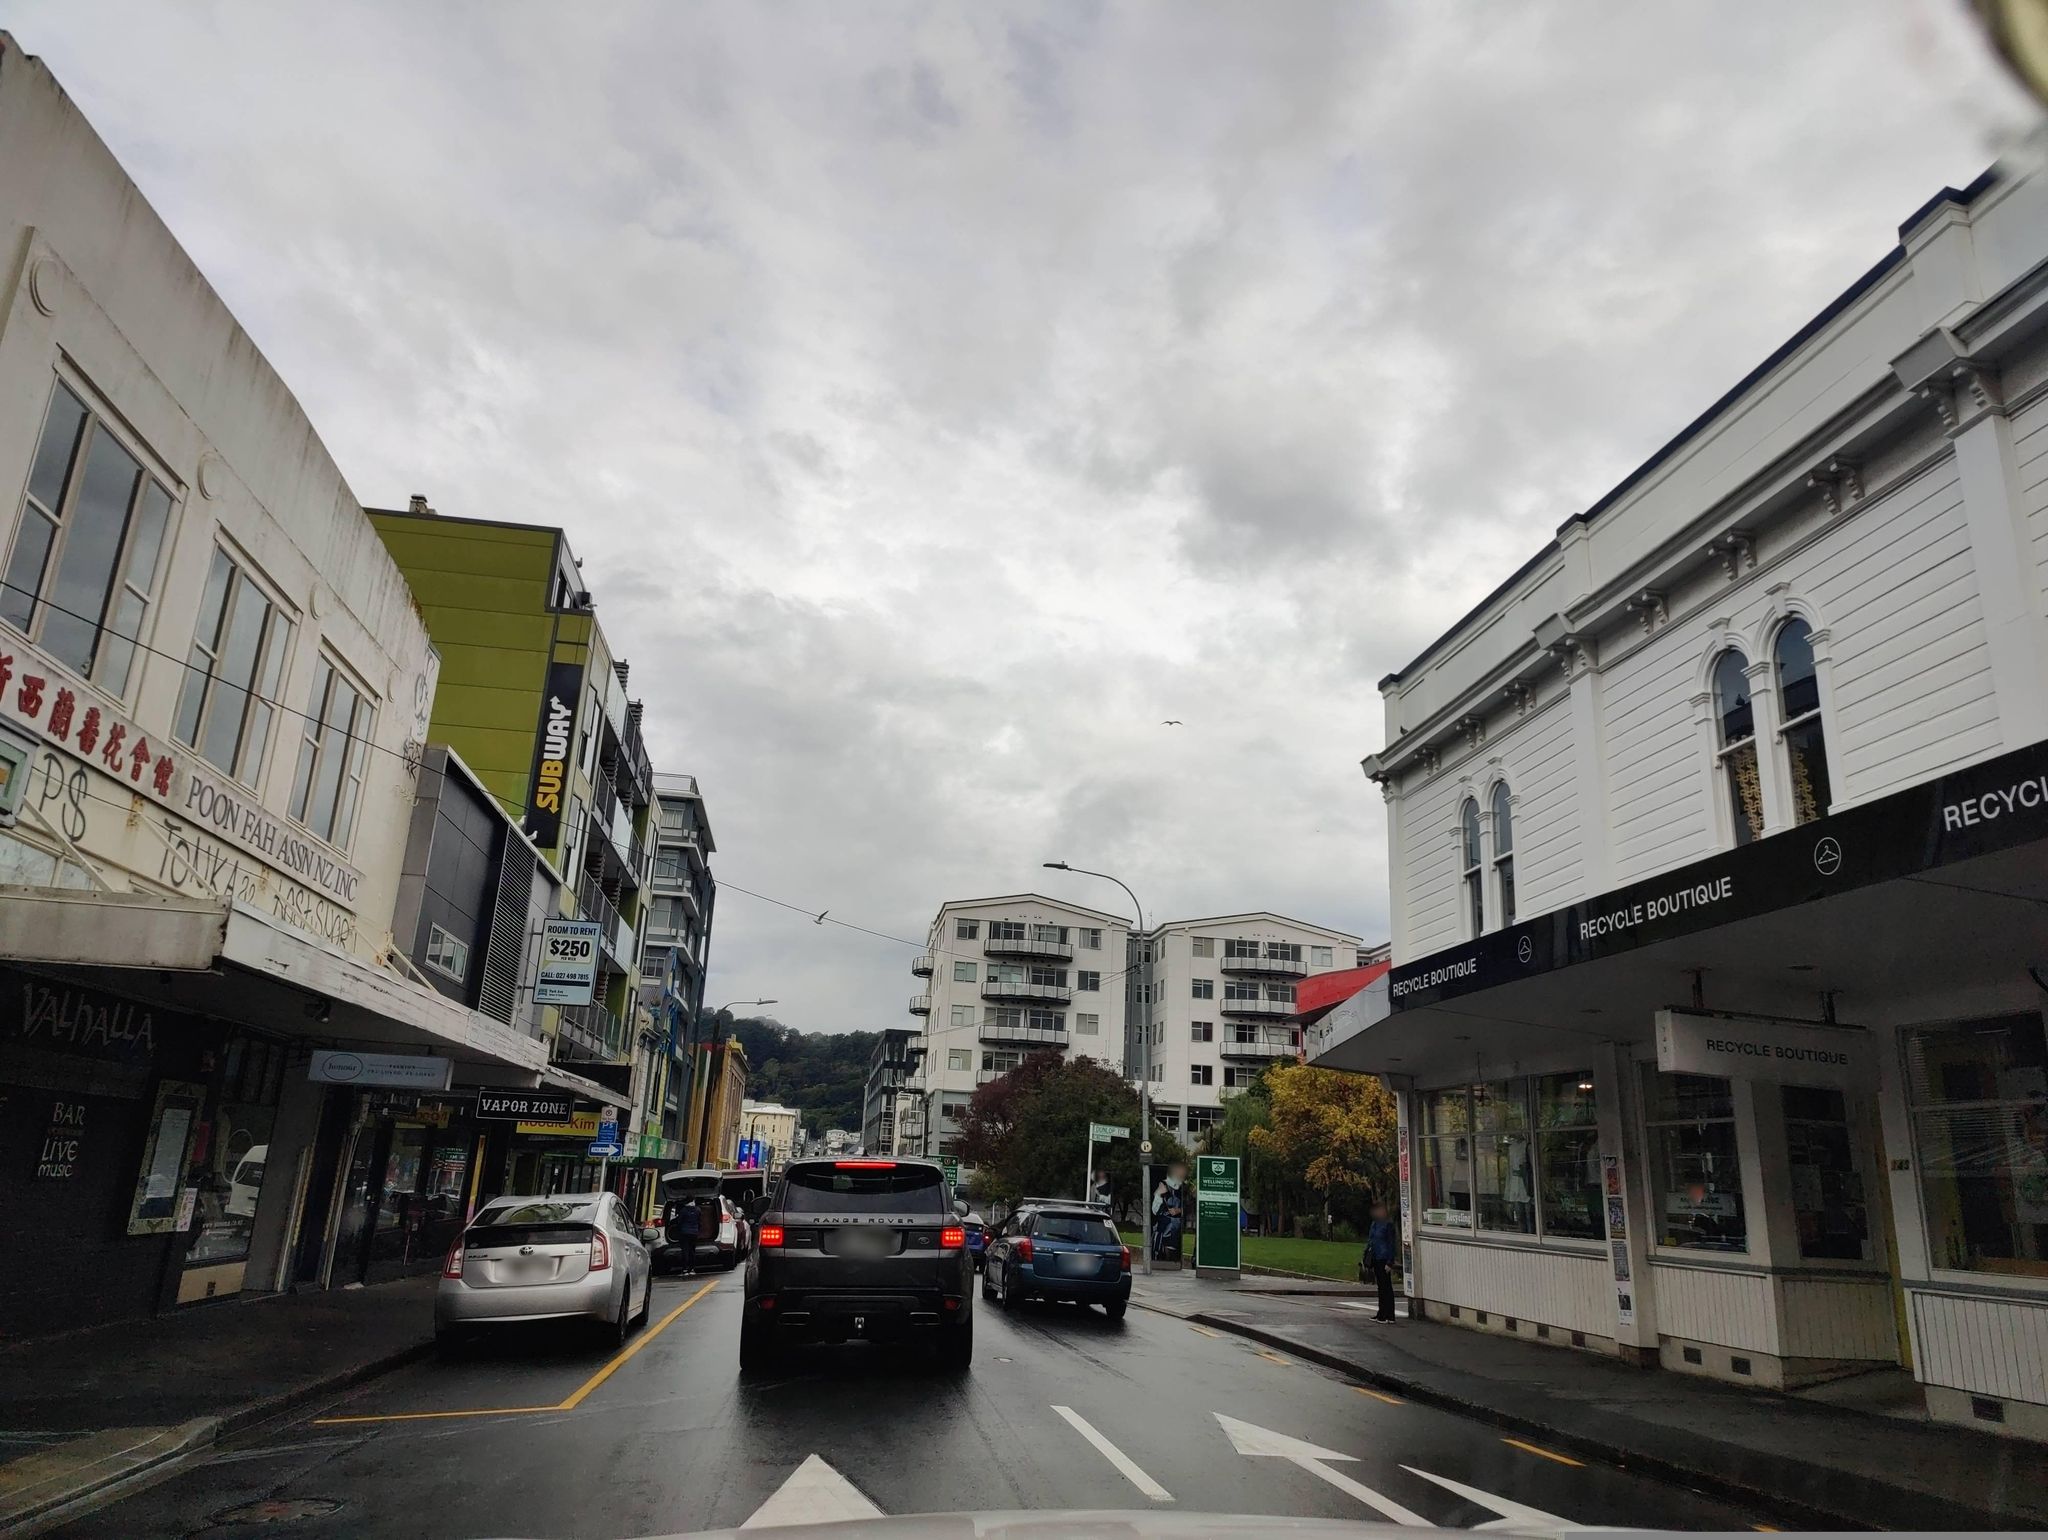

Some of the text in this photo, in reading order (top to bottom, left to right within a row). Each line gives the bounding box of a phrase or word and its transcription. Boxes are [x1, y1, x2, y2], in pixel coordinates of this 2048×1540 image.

[536, 695, 572, 814] SUBWAY
[185, 775, 358, 902] POON FAH ASSN NZ INC
[1580, 876, 1733, 941] RECYCLE BOUTIQUE
[547, 925, 597, 936] ROOM TO RENT
[549, 938, 590, 958] $250
[541, 971, 555, 979] CALL:
[1393, 958, 1477, 997] RECYCLE BOUTIQUE
[1706, 1039, 1849, 1066] RECYCLE BOUTIQUE
[53, 1102, 86, 1126] BAR
[481, 1098, 568, 1115] VAPOR ZONE
[570, 1117, 595, 1130] Kim
[42, 1138, 79, 1162] LIVE
[38, 1164, 73, 1178] music
